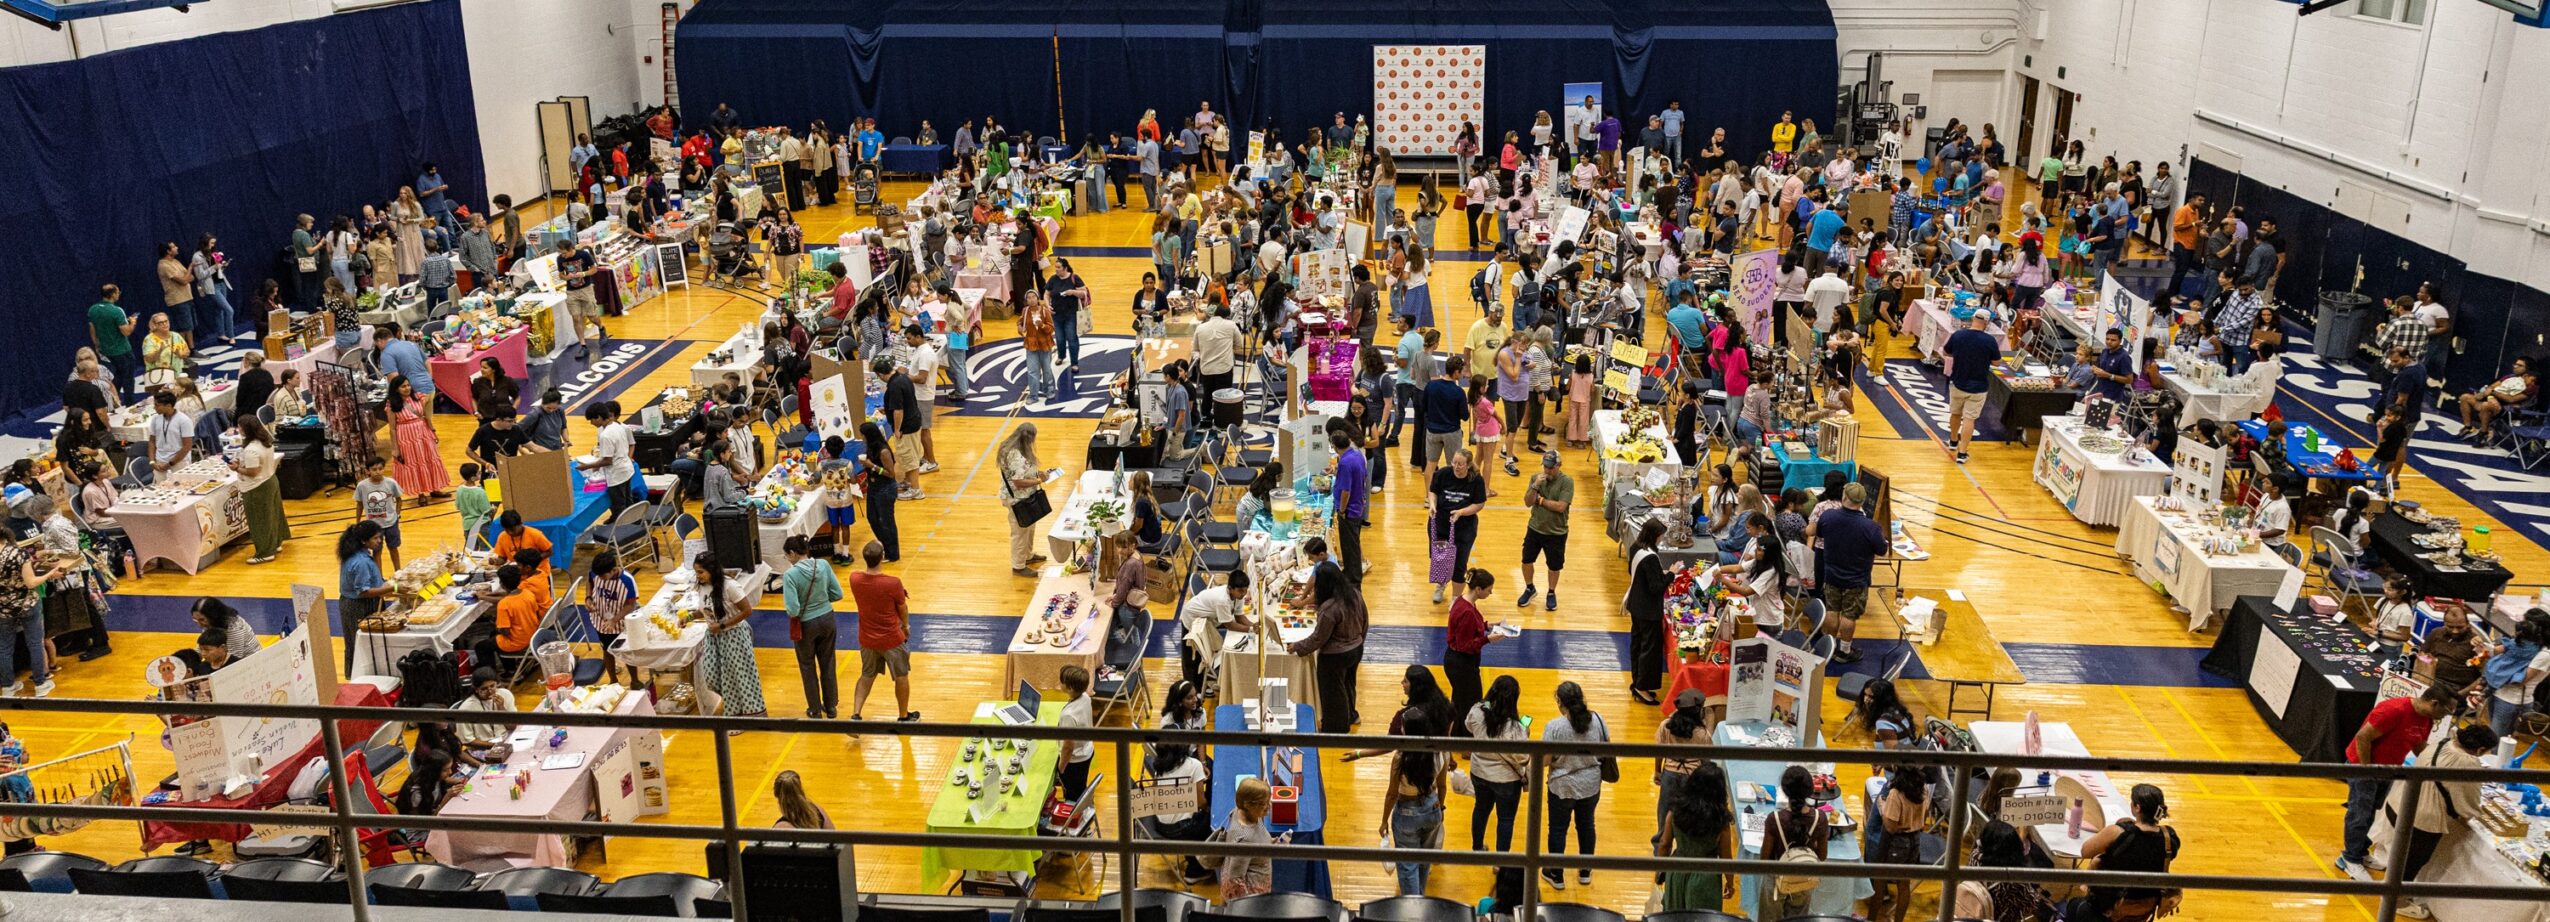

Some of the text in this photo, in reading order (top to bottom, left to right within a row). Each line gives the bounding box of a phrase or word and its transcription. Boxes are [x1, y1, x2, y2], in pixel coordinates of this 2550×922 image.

[540, 343, 645, 404] ALCONS
[189, 740, 211, 751] Food
[184, 747, 221, 761] Midwest
[1158, 788, 1185, 796] Booth
[1177, 800, 1194, 808] E10
[2005, 800, 2034, 808] Booth
[2002, 814, 2015, 822] D1
[2025, 813, 2043, 821] D10
